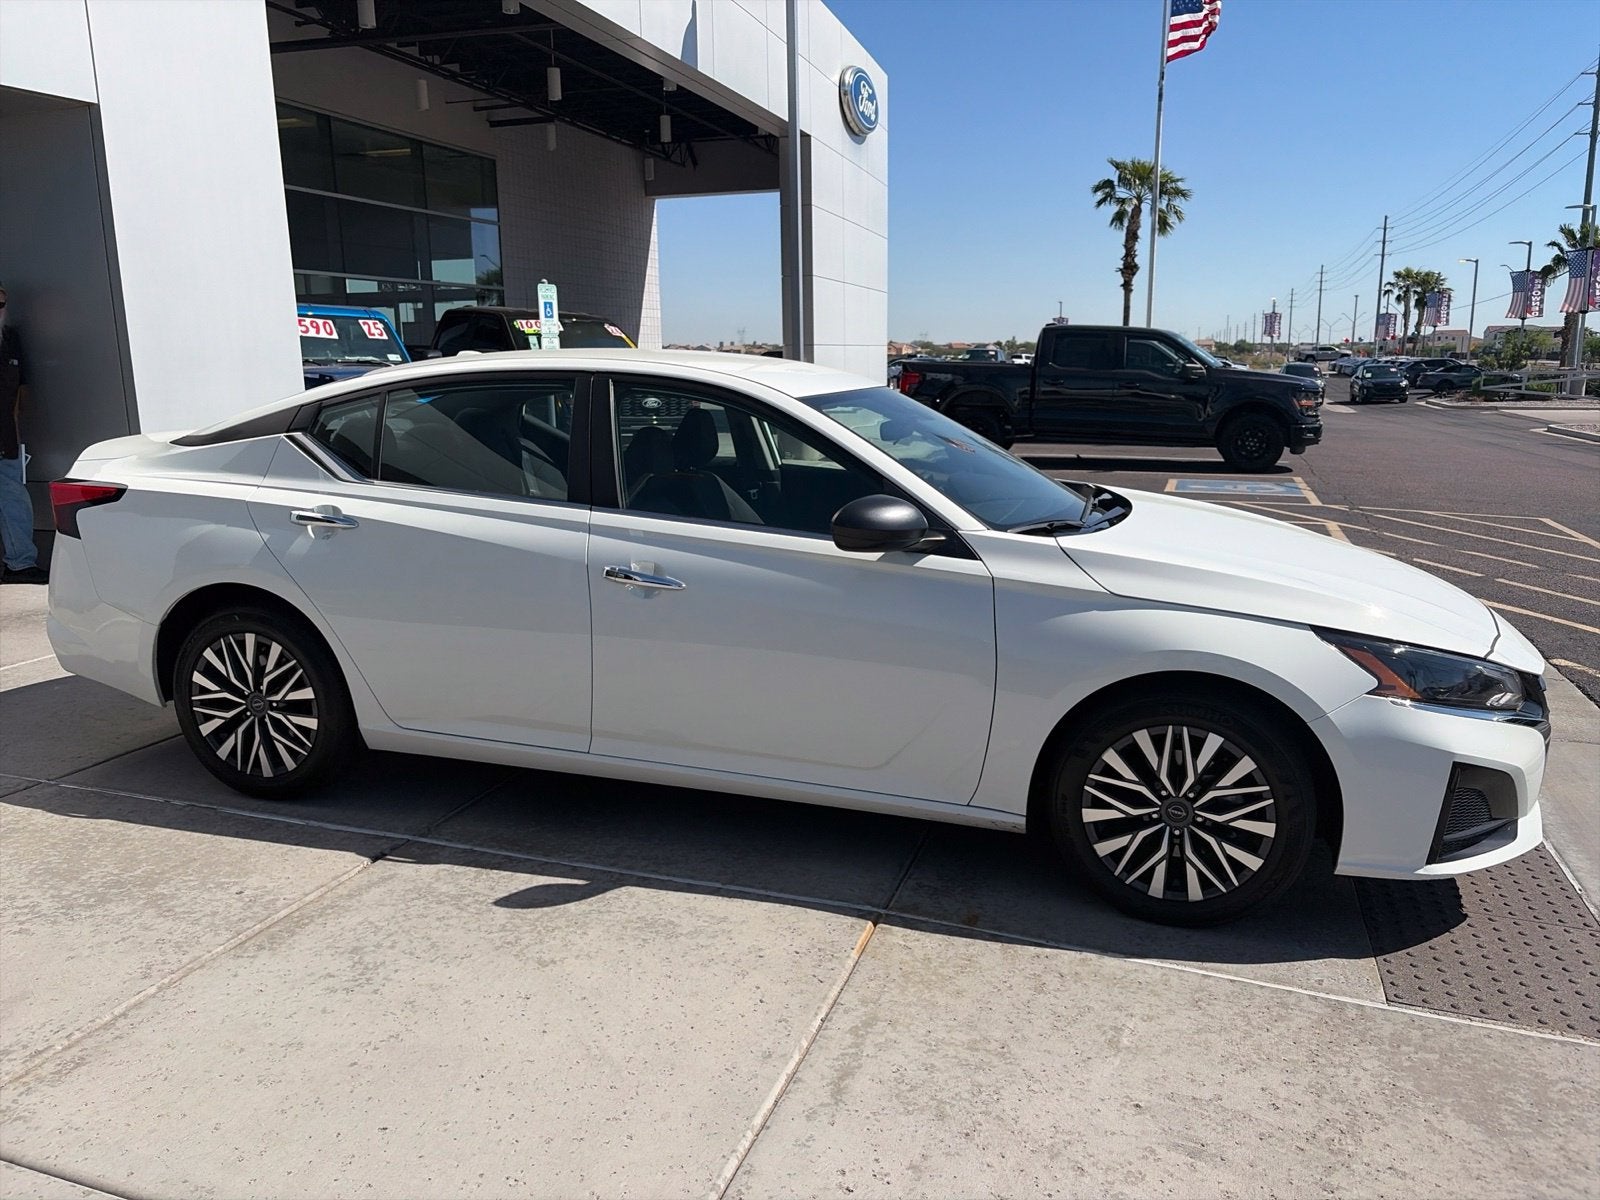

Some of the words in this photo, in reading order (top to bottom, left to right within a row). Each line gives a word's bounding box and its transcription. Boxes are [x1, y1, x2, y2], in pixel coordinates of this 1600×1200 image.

[858, 80, 877, 122] Ford
[298, 319, 334, 336] 590
[362, 321, 385, 337] 25
